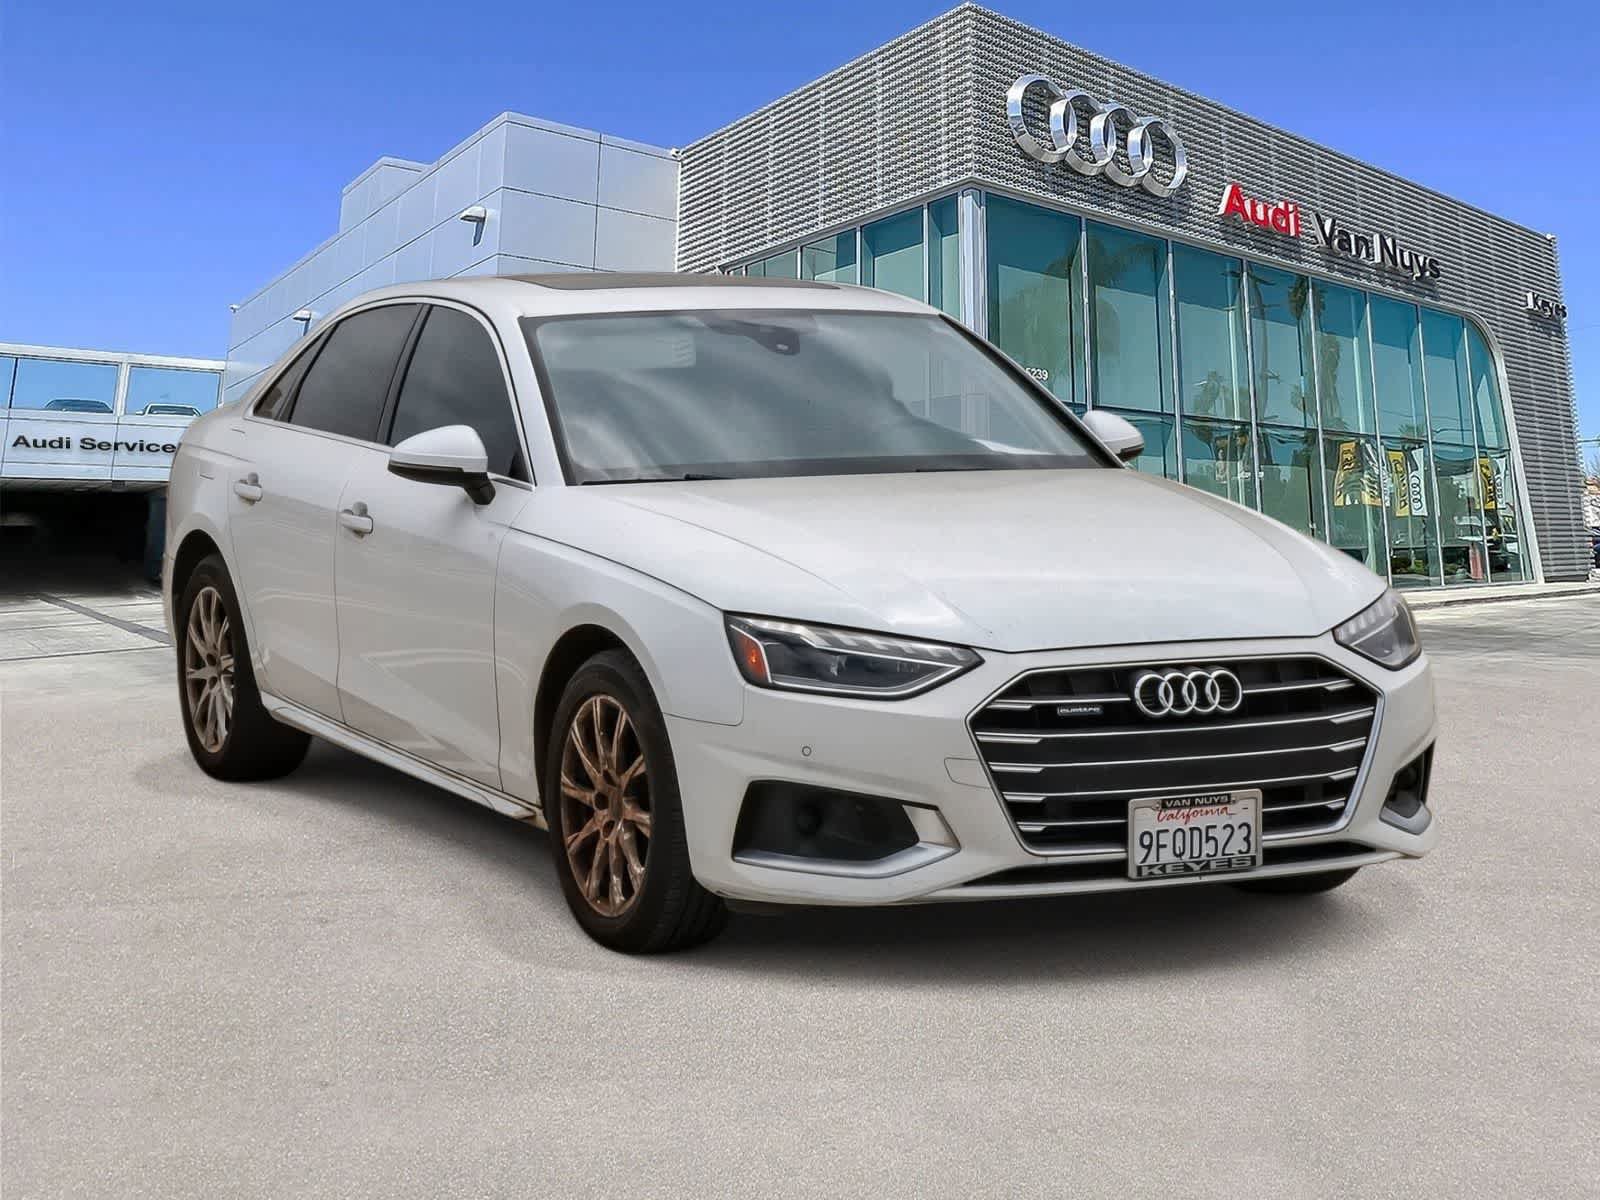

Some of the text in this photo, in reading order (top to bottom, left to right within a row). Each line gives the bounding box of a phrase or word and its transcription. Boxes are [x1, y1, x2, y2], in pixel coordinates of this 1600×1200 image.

[1219, 183, 1441, 281] Audi Van Nuys
[12, 434, 177, 454] Audi Service
[1165, 795, 1229, 808] VAN NUYS
[1157, 806, 1229, 825] California
[1139, 822, 1251, 864] 9FQD523
[1141, 856, 1253, 877] KEYES
